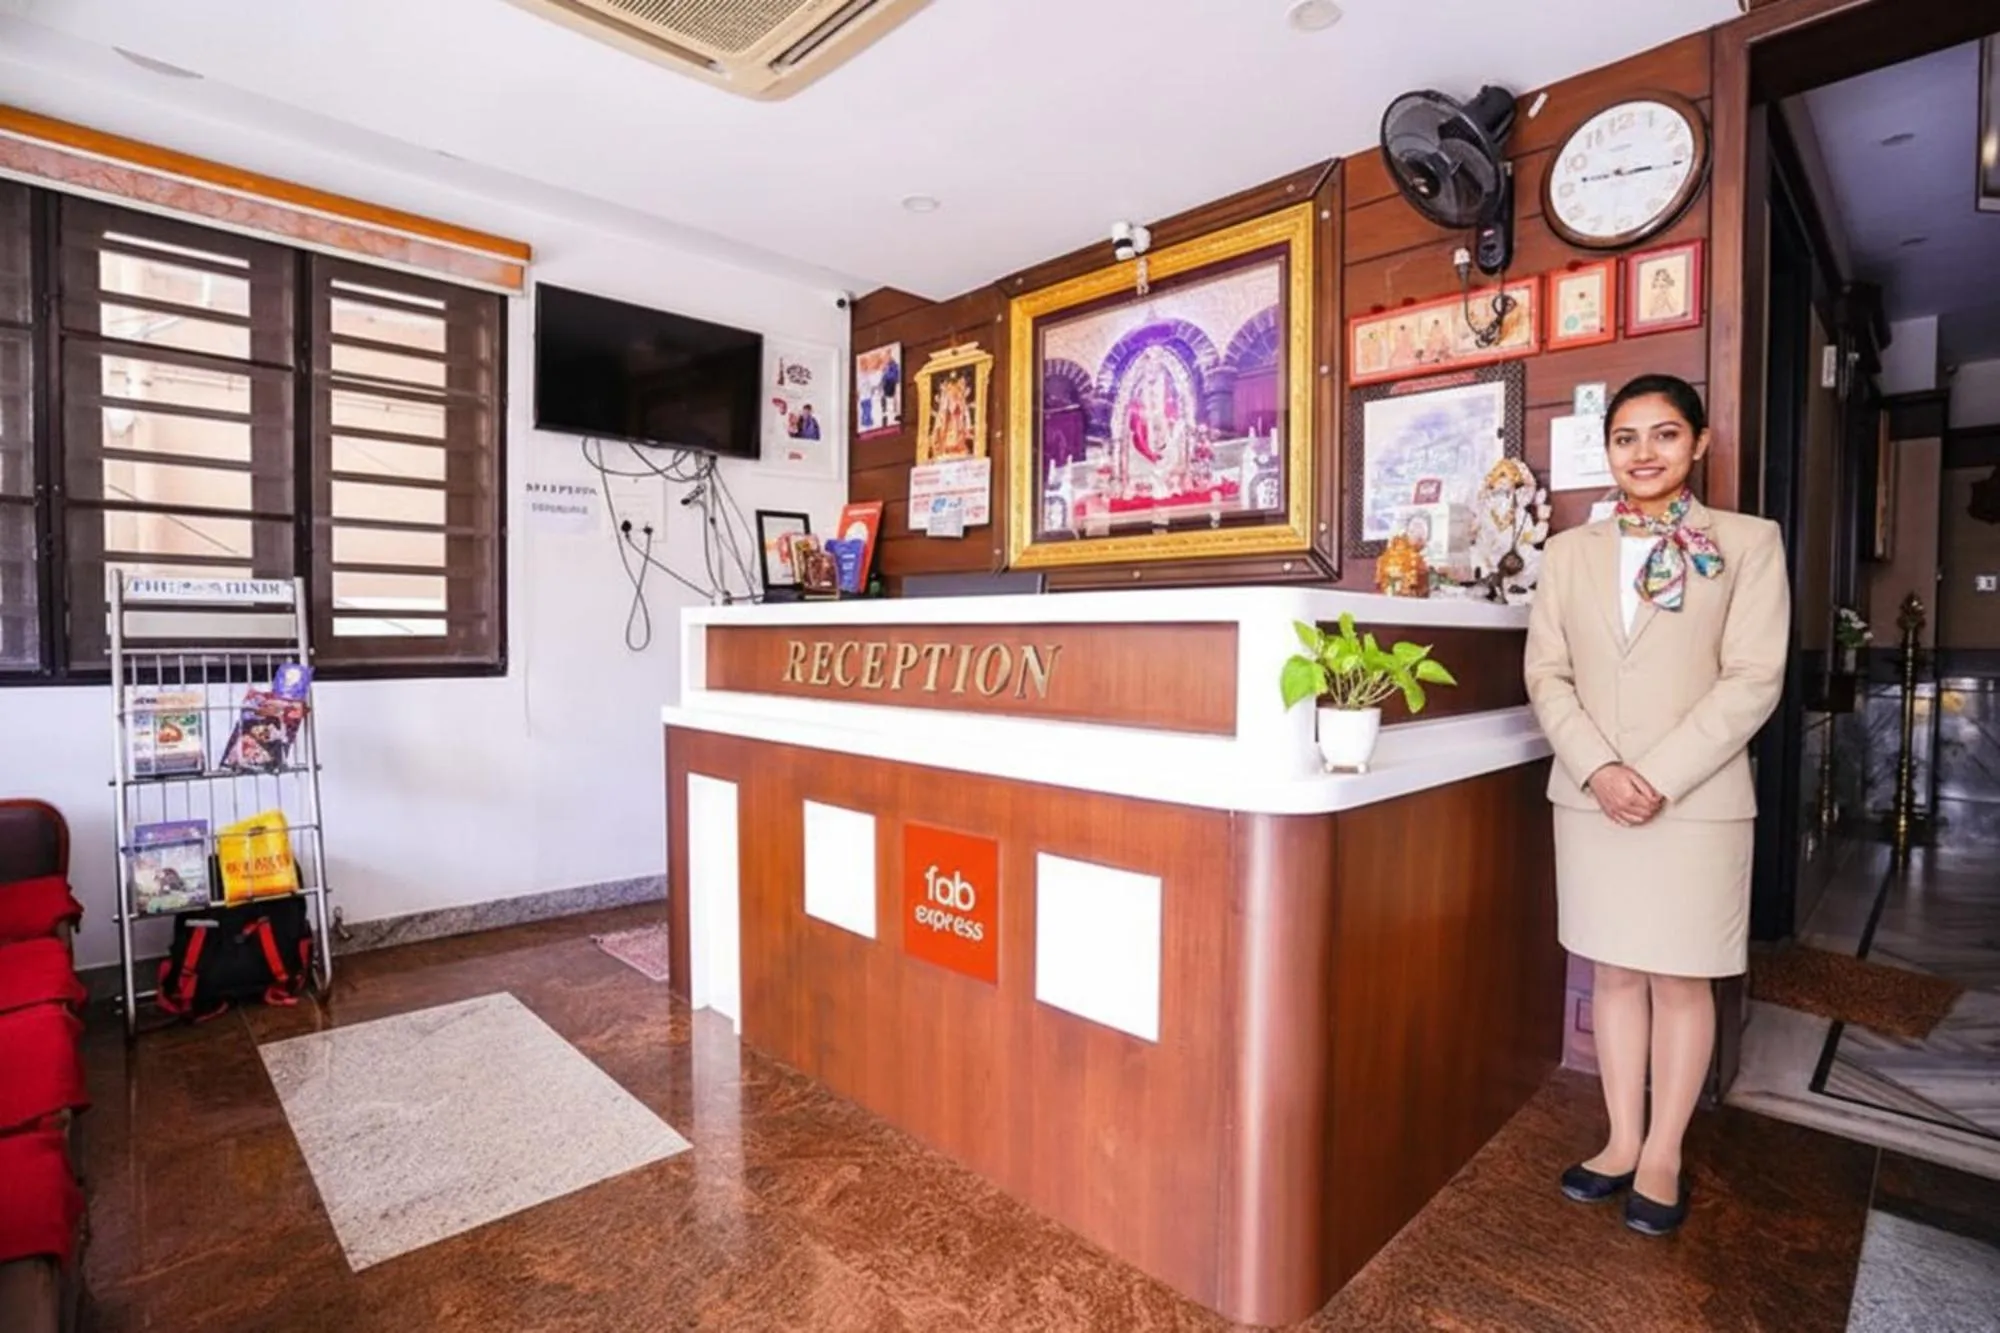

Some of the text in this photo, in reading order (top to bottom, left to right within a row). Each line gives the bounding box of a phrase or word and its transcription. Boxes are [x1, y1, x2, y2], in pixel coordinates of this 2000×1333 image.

[782, 639, 1062, 700] RECEPTION
[924, 865, 976, 912] fab
[914, 904, 984, 941] express
